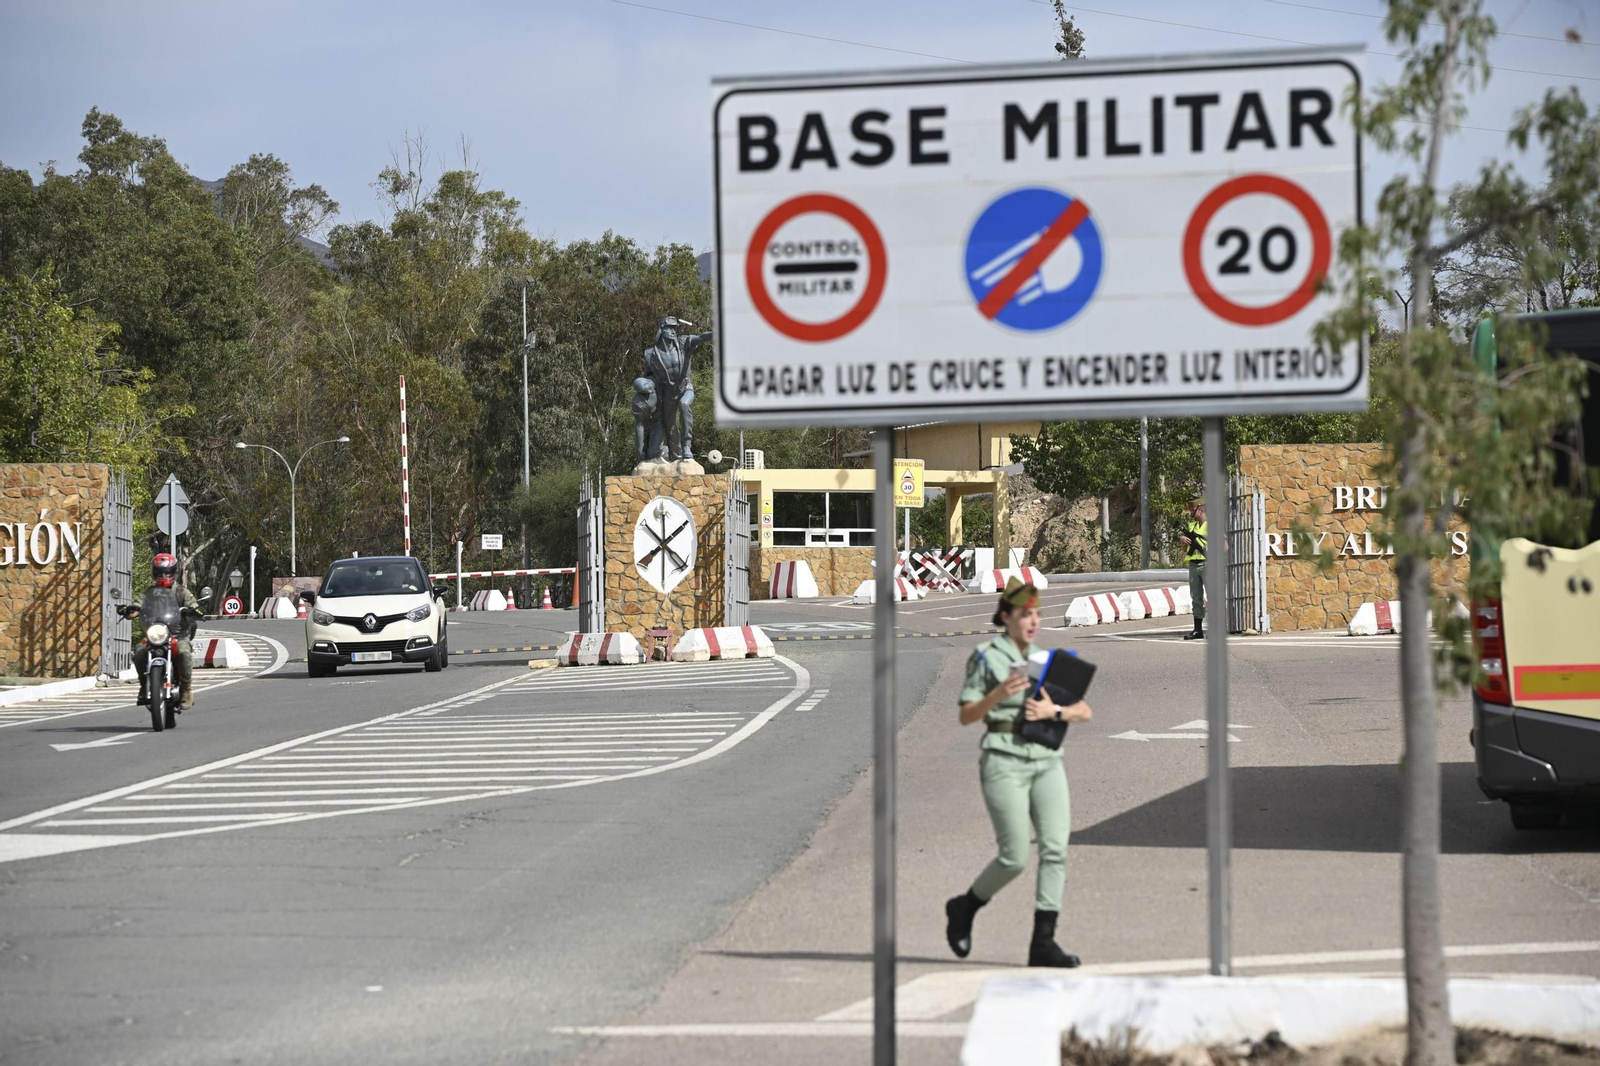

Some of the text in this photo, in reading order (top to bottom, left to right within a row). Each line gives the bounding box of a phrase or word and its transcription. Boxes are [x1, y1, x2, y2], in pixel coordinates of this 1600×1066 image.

[738, 88, 1335, 172] BASE MILITAR
[770, 239, 862, 258] CONTROL
[1217, 225, 1297, 275] 20
[778, 279, 854, 296] MILITAR
[738, 347, 1344, 398] APAGAR LUZ DE CRUCE Y ENCENDER LUZ INTERIOR
